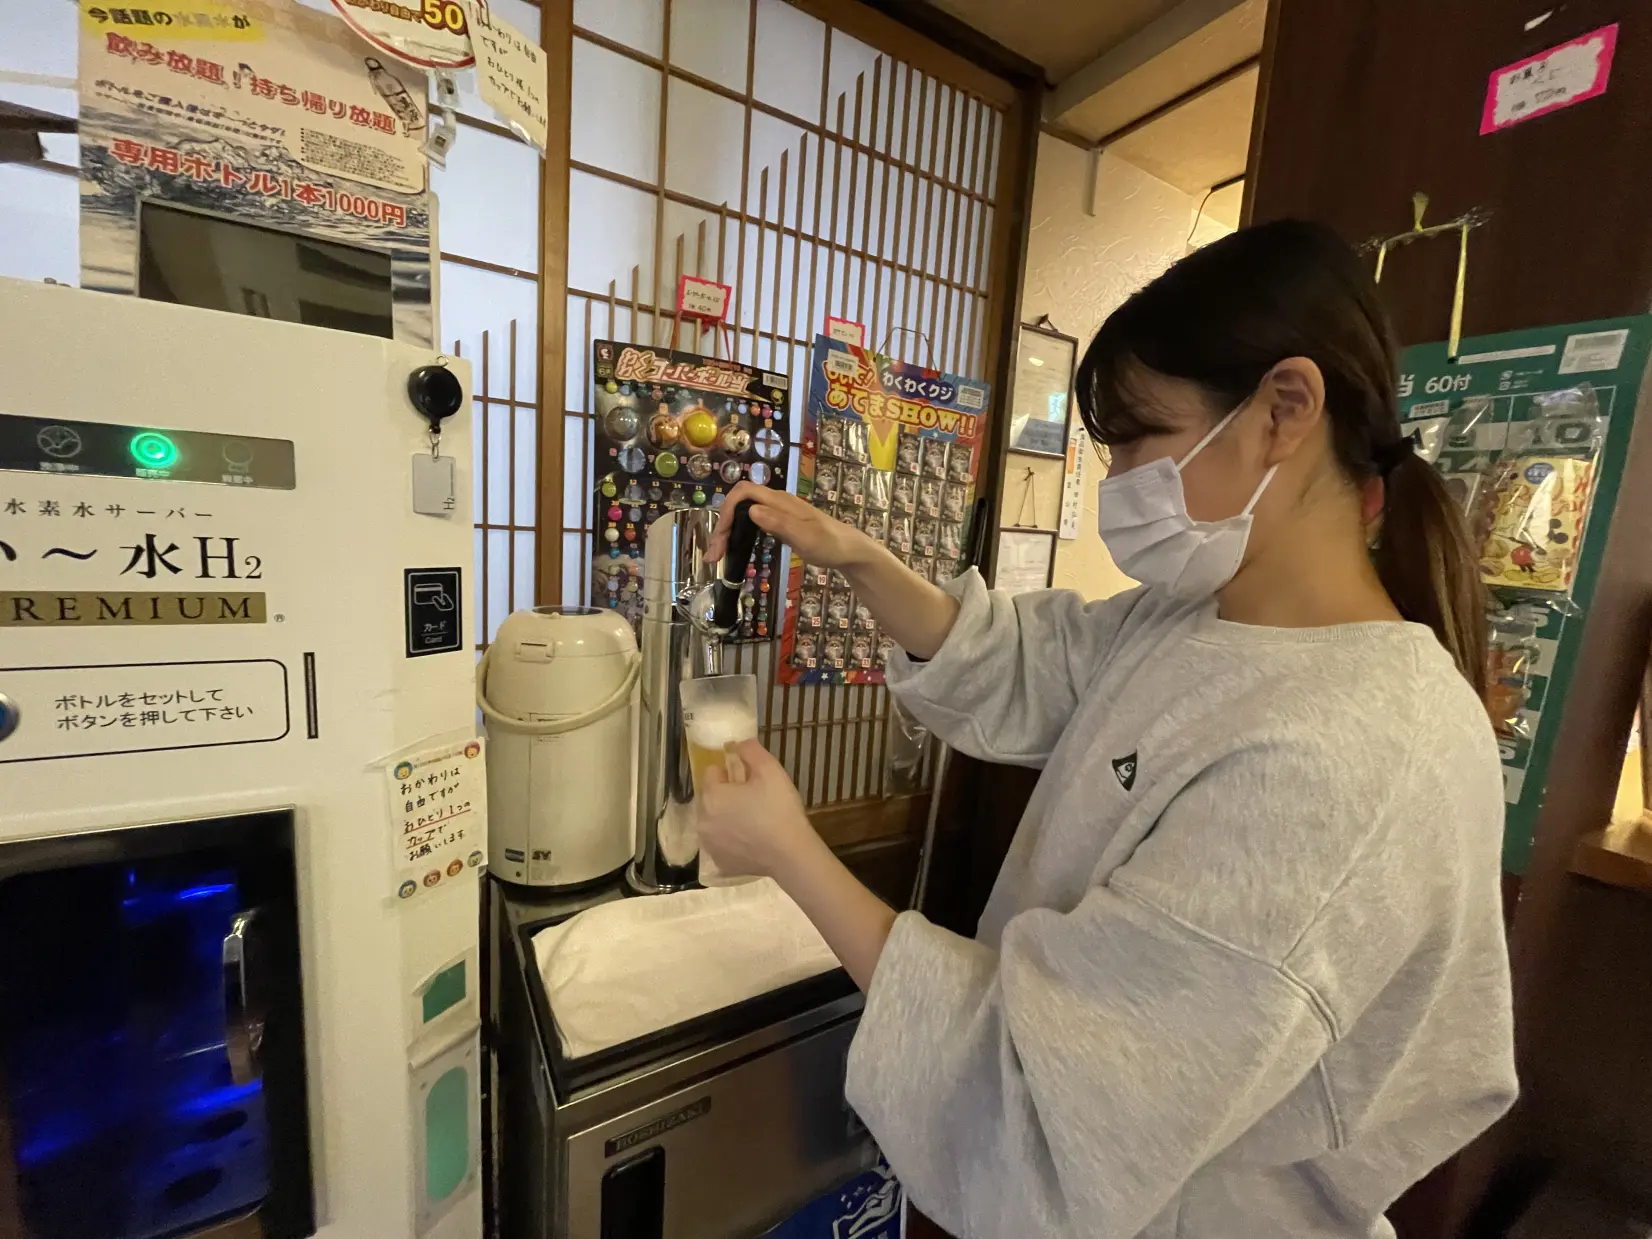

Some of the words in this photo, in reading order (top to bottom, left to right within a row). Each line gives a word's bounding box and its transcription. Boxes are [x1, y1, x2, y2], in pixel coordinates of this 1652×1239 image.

[882, 371, 953, 401] わくわくクジ
[4, 498, 213, 519] 水素水サーバー
[0, 532, 263, 580] ～水H2
[423, 620, 448, 633] カード
[424, 636, 443, 645] Card
[55, 688, 224, 711] ボトルをセットして
[57, 705, 254, 731] ボタンを押して下さい
[400, 767, 461, 796] おかわりは
[405, 782, 461, 813] 自由ですが
[409, 829, 466, 861] お願いします
